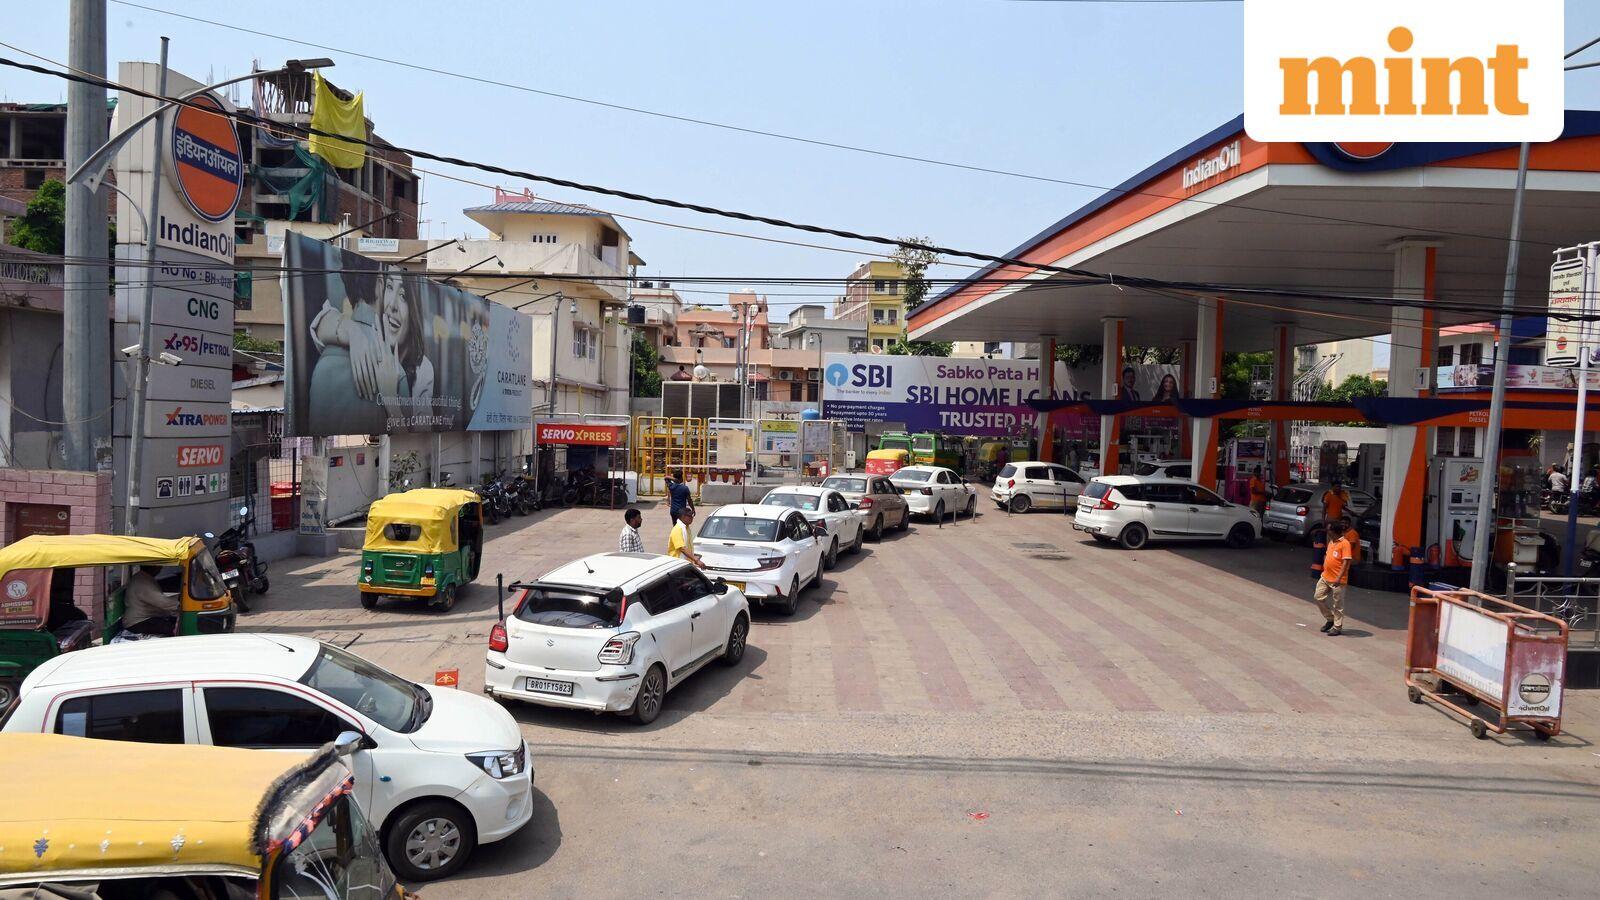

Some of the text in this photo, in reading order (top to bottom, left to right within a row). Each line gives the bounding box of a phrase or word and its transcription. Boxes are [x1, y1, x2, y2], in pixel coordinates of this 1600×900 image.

[176, 133, 238, 176] इंडियनऑयल
[1183, 140, 1241, 188] IndianOil
[160, 215, 233, 258] IndianOil
[187, 298, 219, 320] CNG
[497, 371, 527, 387] CARATLANE
[852, 364, 893, 388] SBI
[936, 365, 985, 380] Sabko
[988, 367, 1023, 381] Pata
[190, 378, 216, 391] DIESEL
[906, 386, 939, 403] SBI
[945, 387, 1010, 406] HOME
[939, 411, 1017, 428] TRUSTED
[180, 446, 221, 466] SERVO
[530, 680, 572, 693] BR01FY5823
